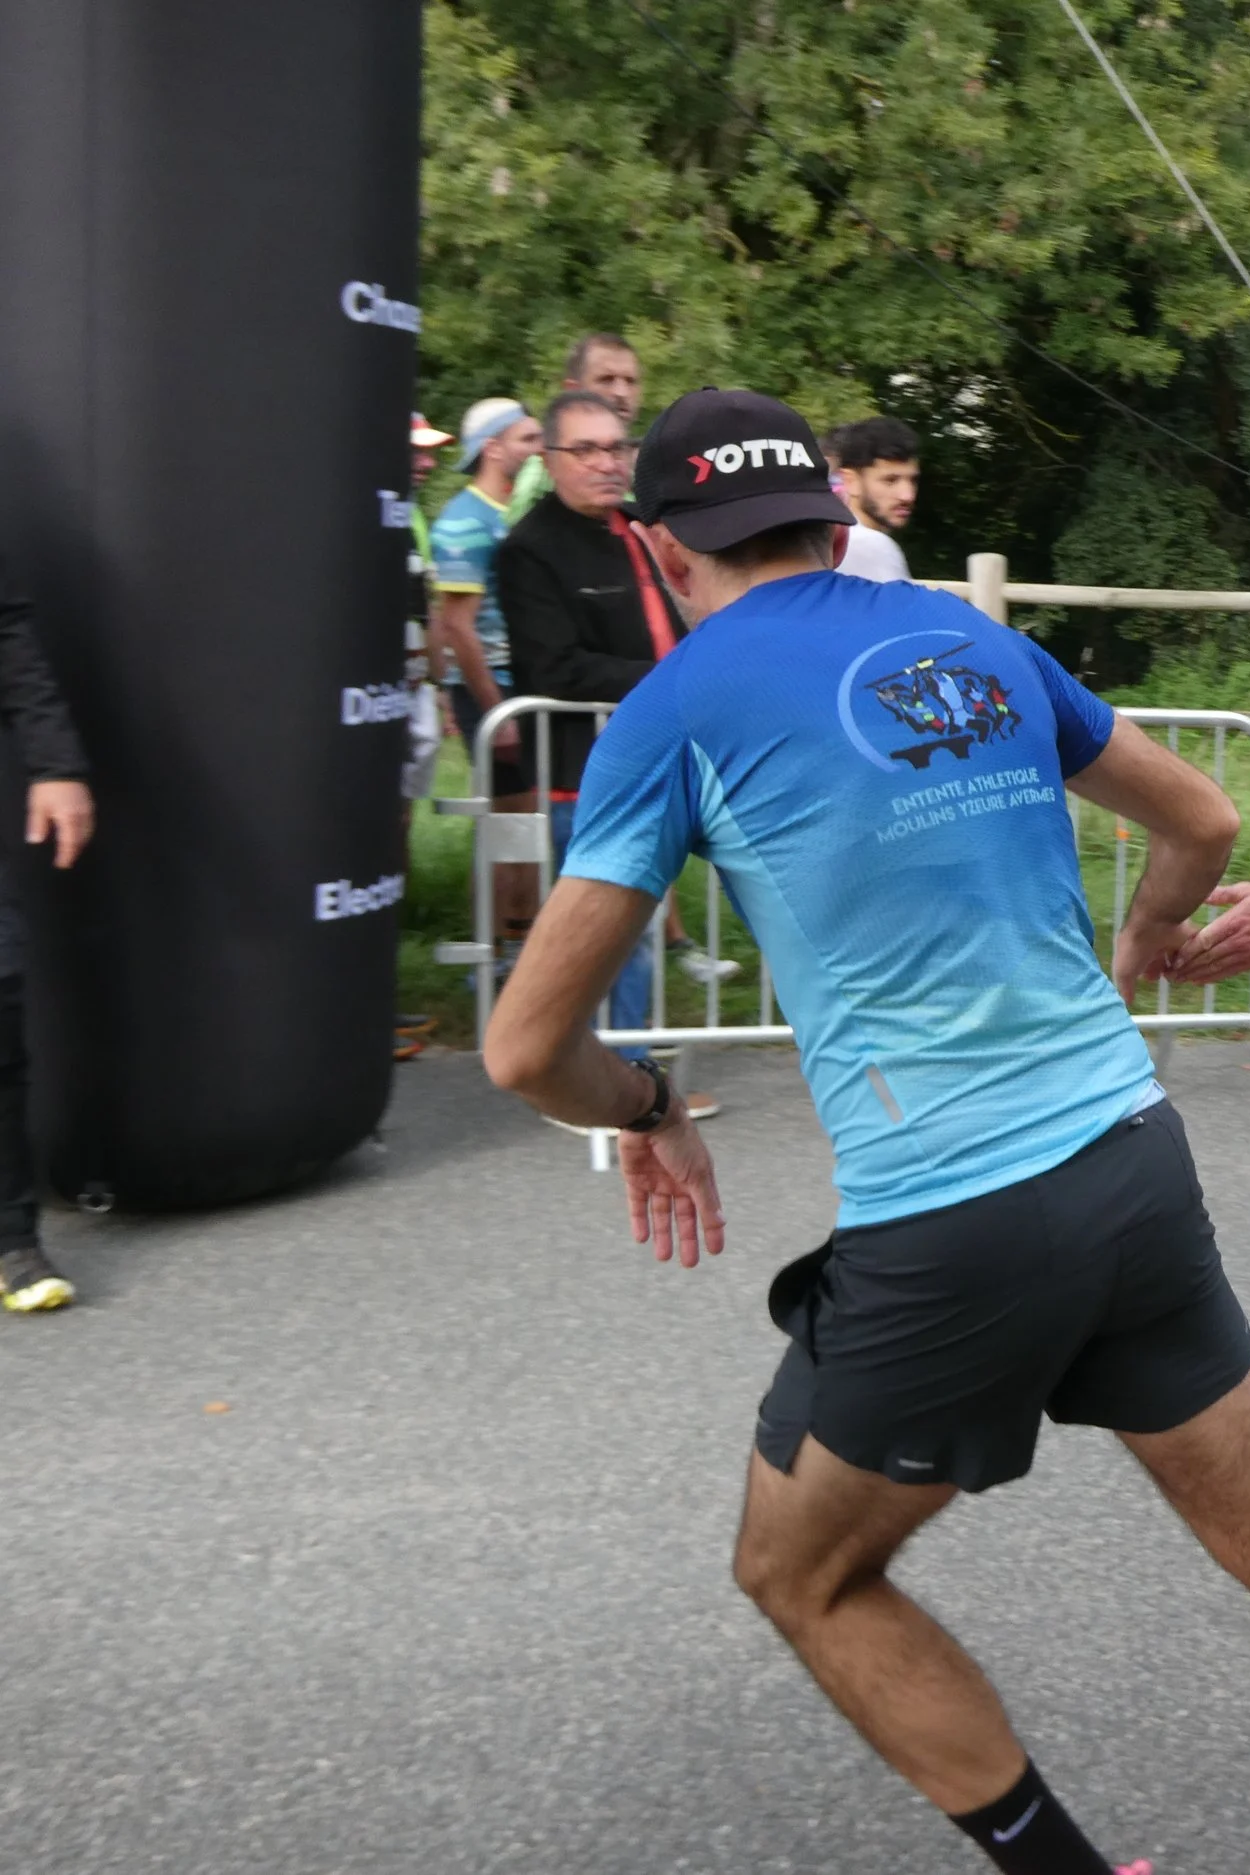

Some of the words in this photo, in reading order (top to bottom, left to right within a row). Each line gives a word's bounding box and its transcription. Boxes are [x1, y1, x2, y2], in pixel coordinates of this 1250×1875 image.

[687, 438, 815, 484] YOTTA
[875, 805, 956, 844] MOULINS
[957, 792, 1007, 817] YZEURE
[1009, 786, 1056, 808] AVERMES
[891, 780, 965, 816] ENTENTE
[967, 767, 1040, 795] ATHLETIQUE
